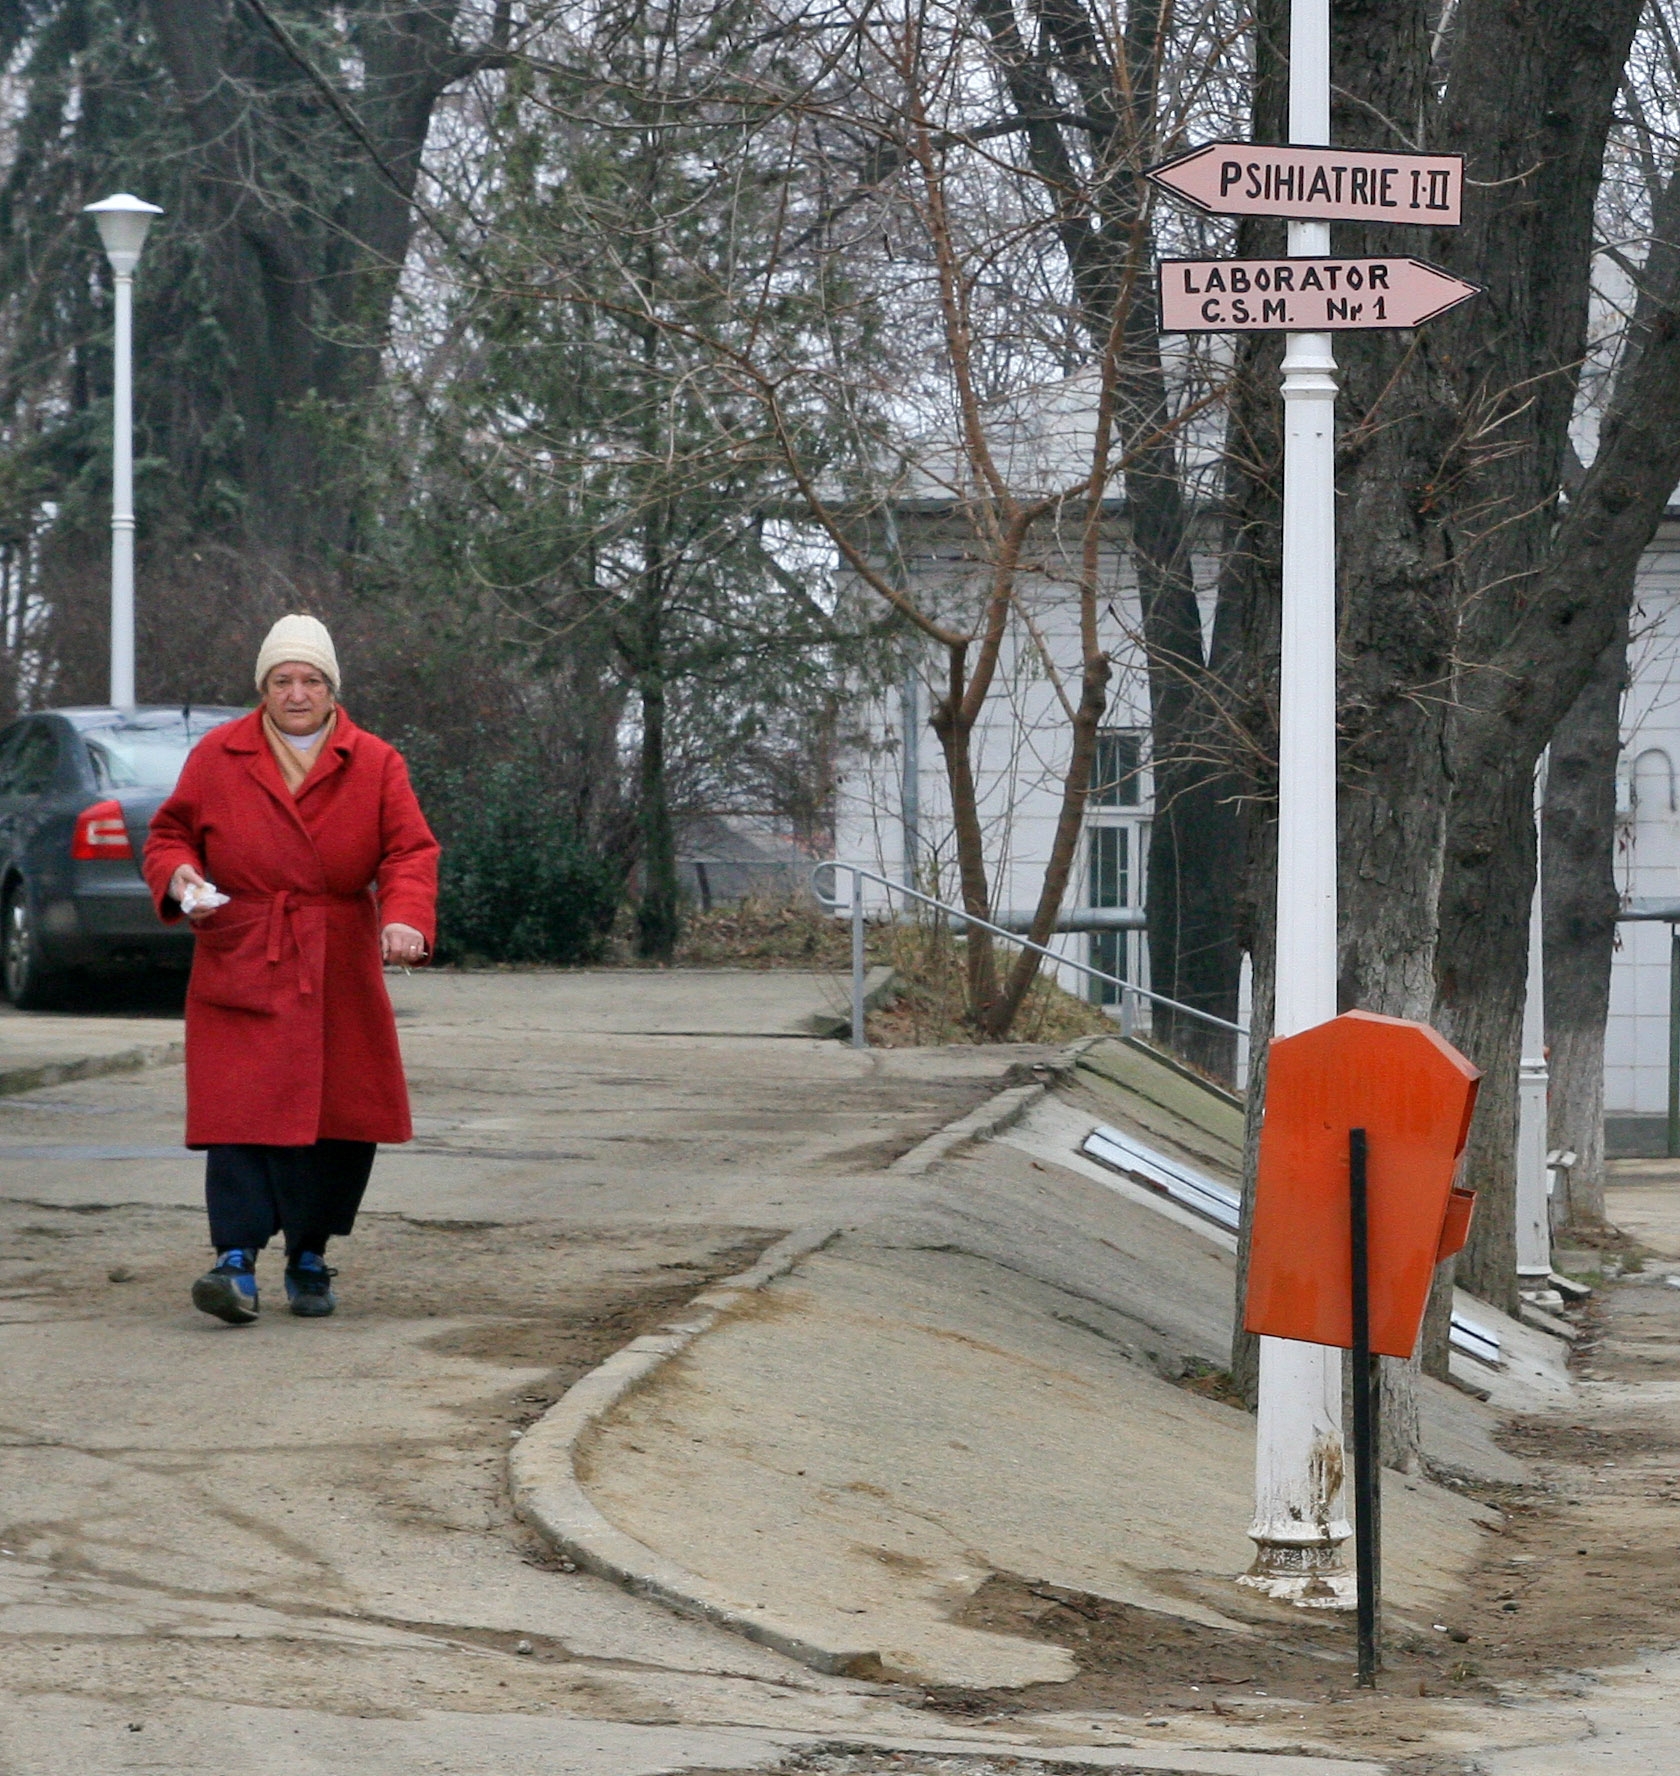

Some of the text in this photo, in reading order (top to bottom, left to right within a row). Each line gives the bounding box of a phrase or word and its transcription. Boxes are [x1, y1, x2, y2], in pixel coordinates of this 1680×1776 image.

[1220, 161, 1399, 208] PSIHIATRIE
[1183, 264, 1390, 295] LABORATOR
[1201, 297, 1295, 324] C.S.M.
[1372, 295, 1388, 321] 1
